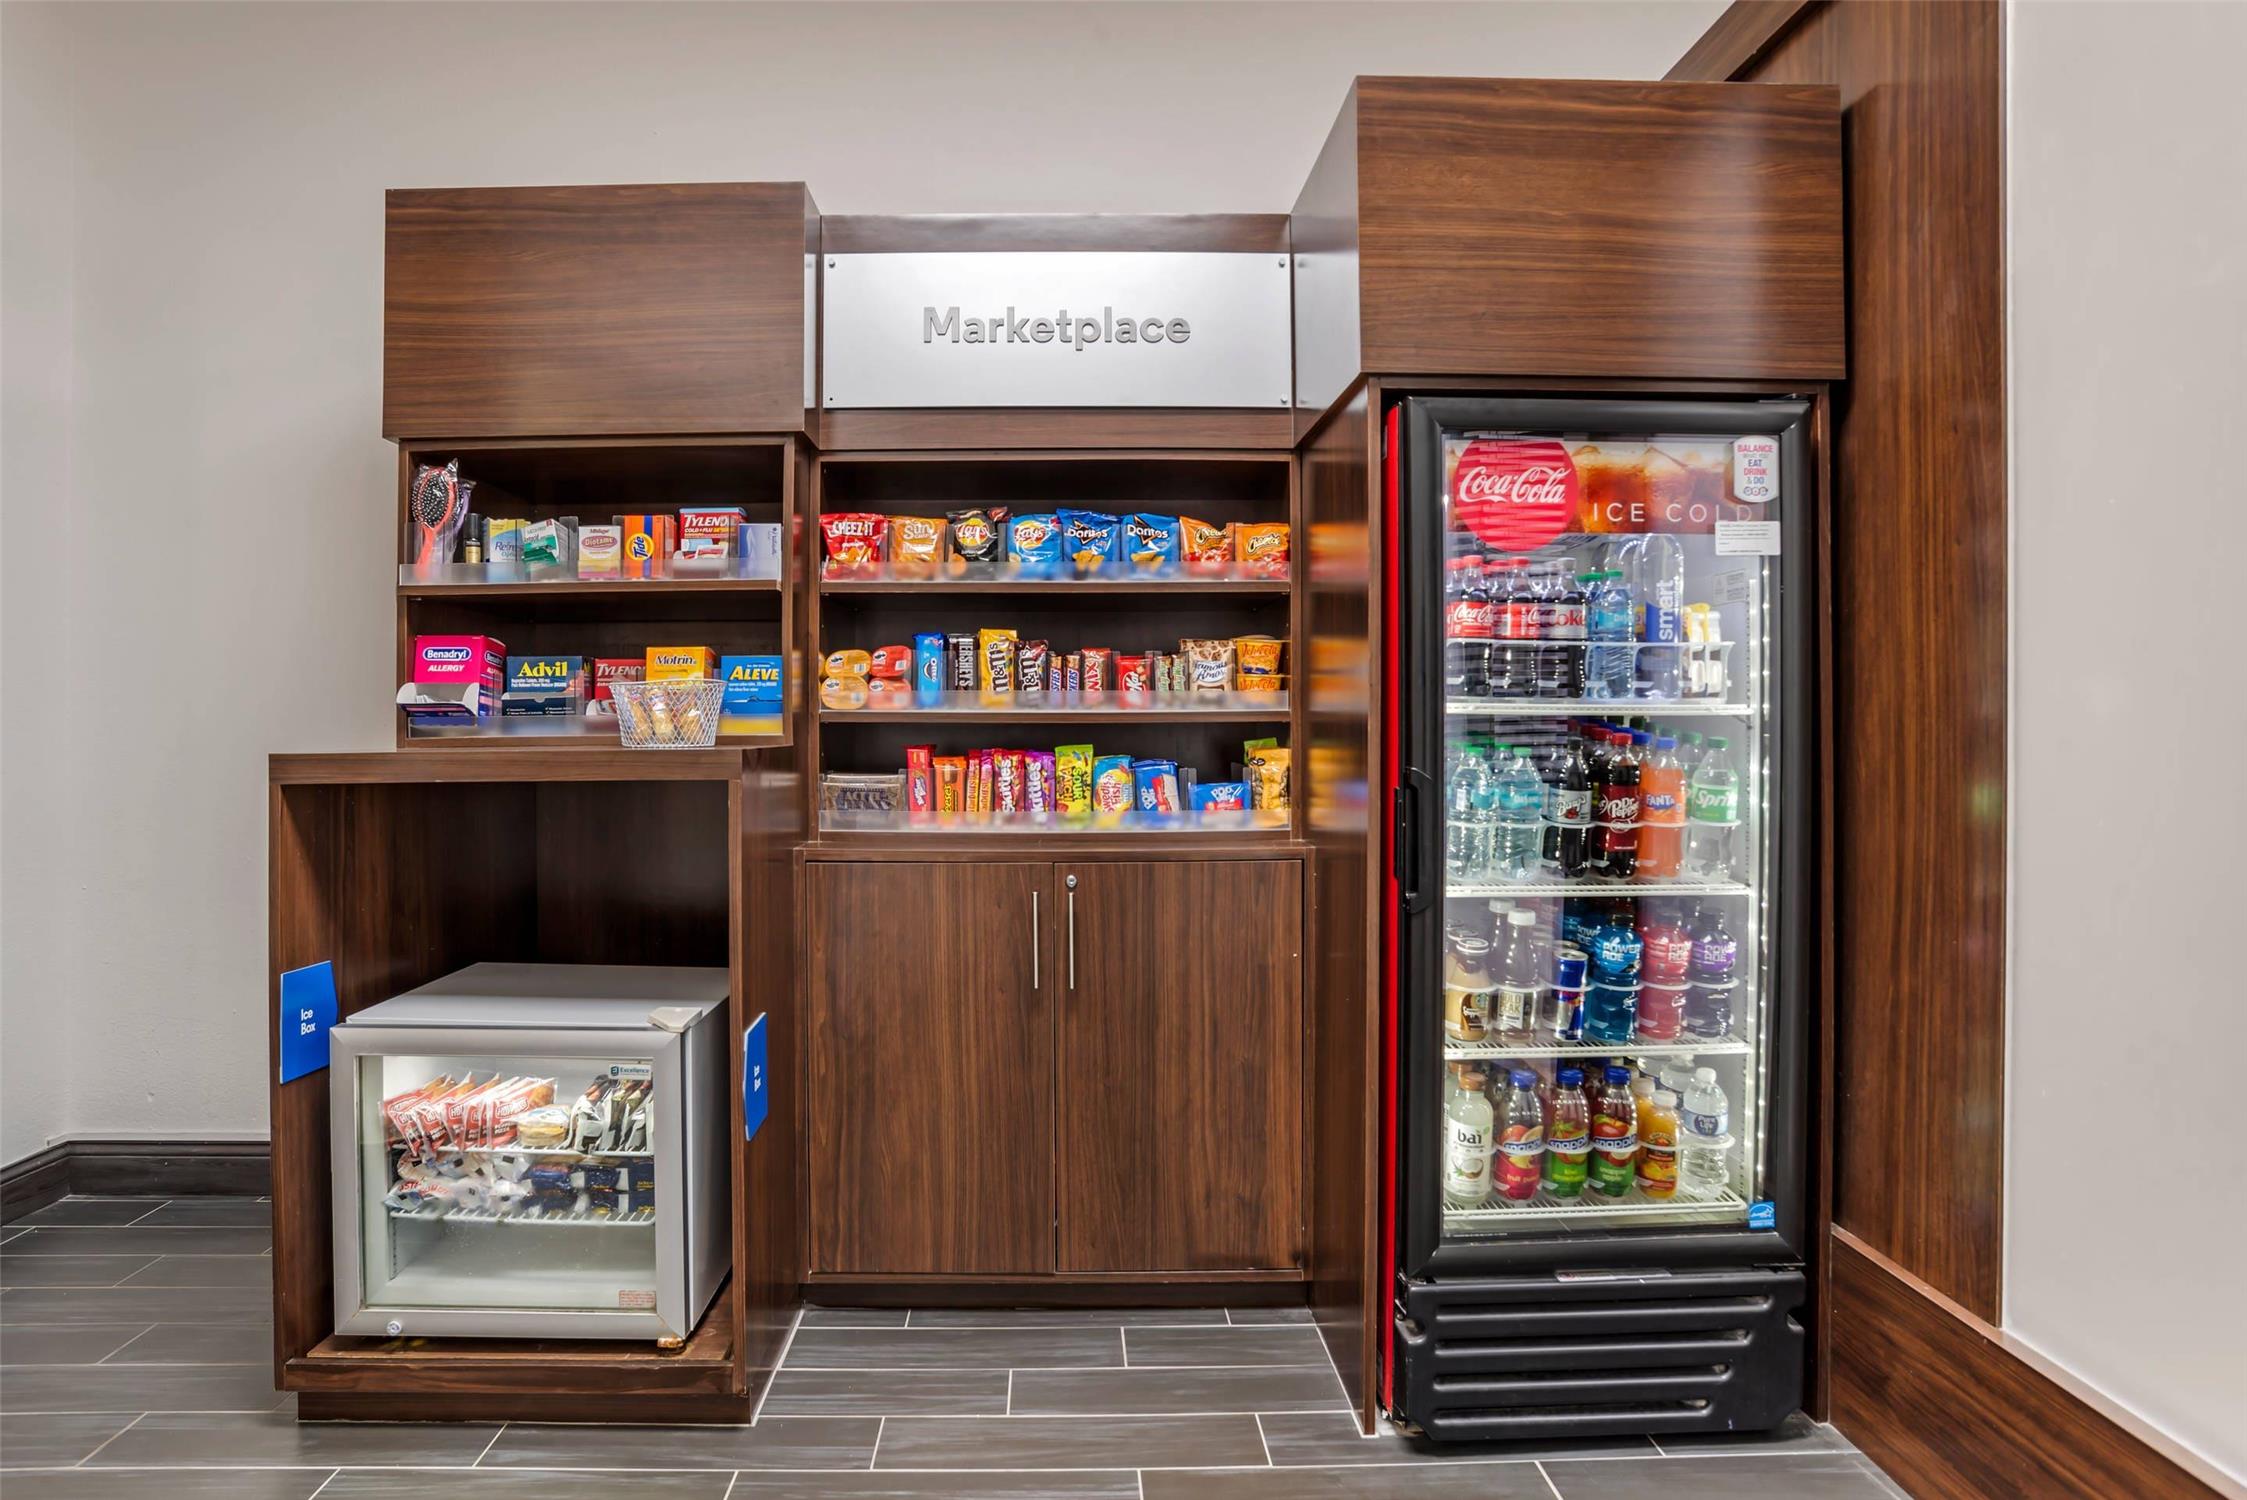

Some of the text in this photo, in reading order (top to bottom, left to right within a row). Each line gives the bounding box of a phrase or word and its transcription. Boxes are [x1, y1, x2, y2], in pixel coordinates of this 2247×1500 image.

[922, 306, 1192, 351] Marketplace
[1737, 444, 1774, 453] BALANCE
[1748, 459, 1762, 467] EAT
[1743, 468, 1768, 476] DRINK
[1459, 466, 1572, 503] Coca-Cola
[1593, 503, 1753, 522] ICE COLD
[1127, 524, 1169, 539] Doritos
[633, 536, 648, 560] Tide
[1656, 580, 1674, 640] smart
[427, 649, 468, 661] Benadryl
[655, 654, 693, 666] Motrin
[427, 664, 465, 673] ALLERGY
[517, 661, 568, 677] Advil
[729, 665, 780, 680] ALEVE
[1073, 768, 1083, 801] SOUR
[301, 1008, 314, 1021] Ice
[301, 1022, 316, 1036] Box
[1457, 1128, 1483, 1144] bai
